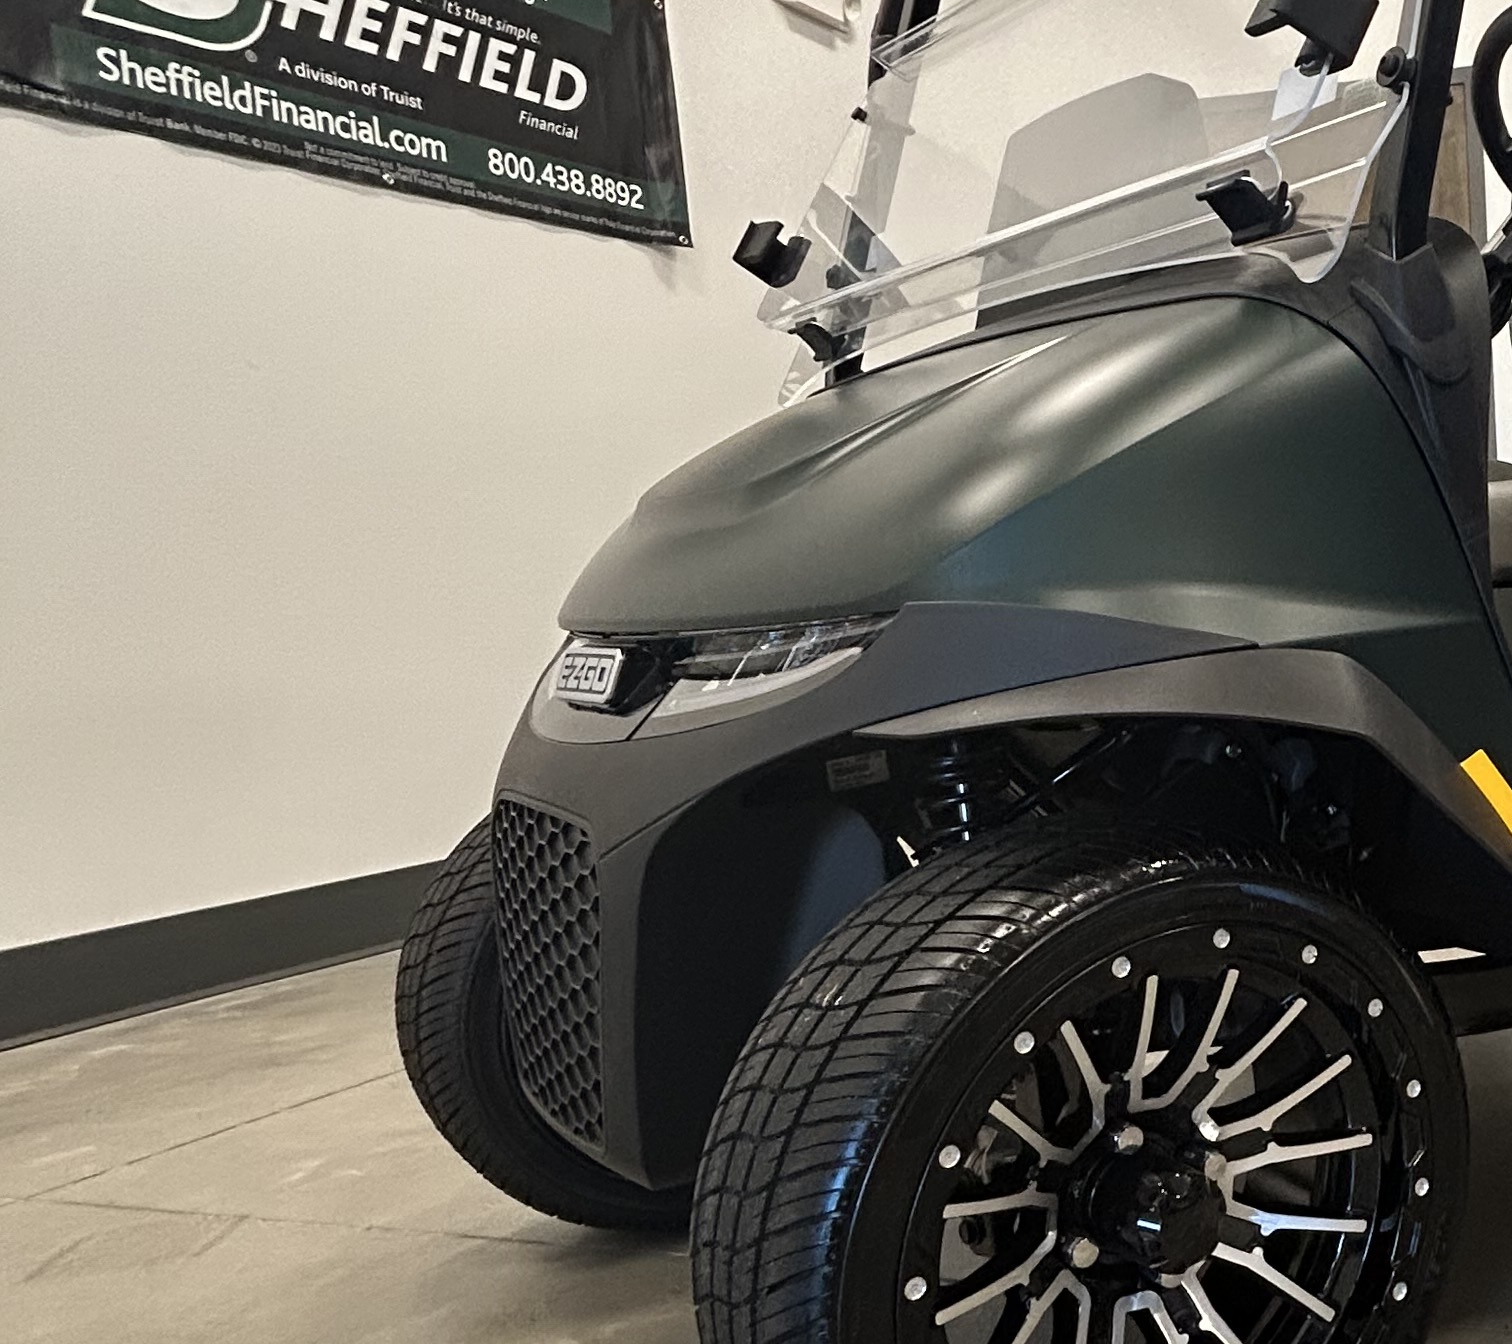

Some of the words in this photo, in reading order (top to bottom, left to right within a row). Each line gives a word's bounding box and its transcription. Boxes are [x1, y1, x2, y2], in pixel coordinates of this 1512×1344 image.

[465, 5, 493, 29] that
[96, 47, 448, 162] SheffieldFinancial.com
[278, 57, 291, 76] A
[294, 62, 357, 93] division
[361, 81, 377, 98] of
[380, 86, 424, 111] Truist
[519, 110, 579, 140] Financial
[487, 148, 645, 210] 800.438.8892
[558, 656, 614, 692] EZGO
